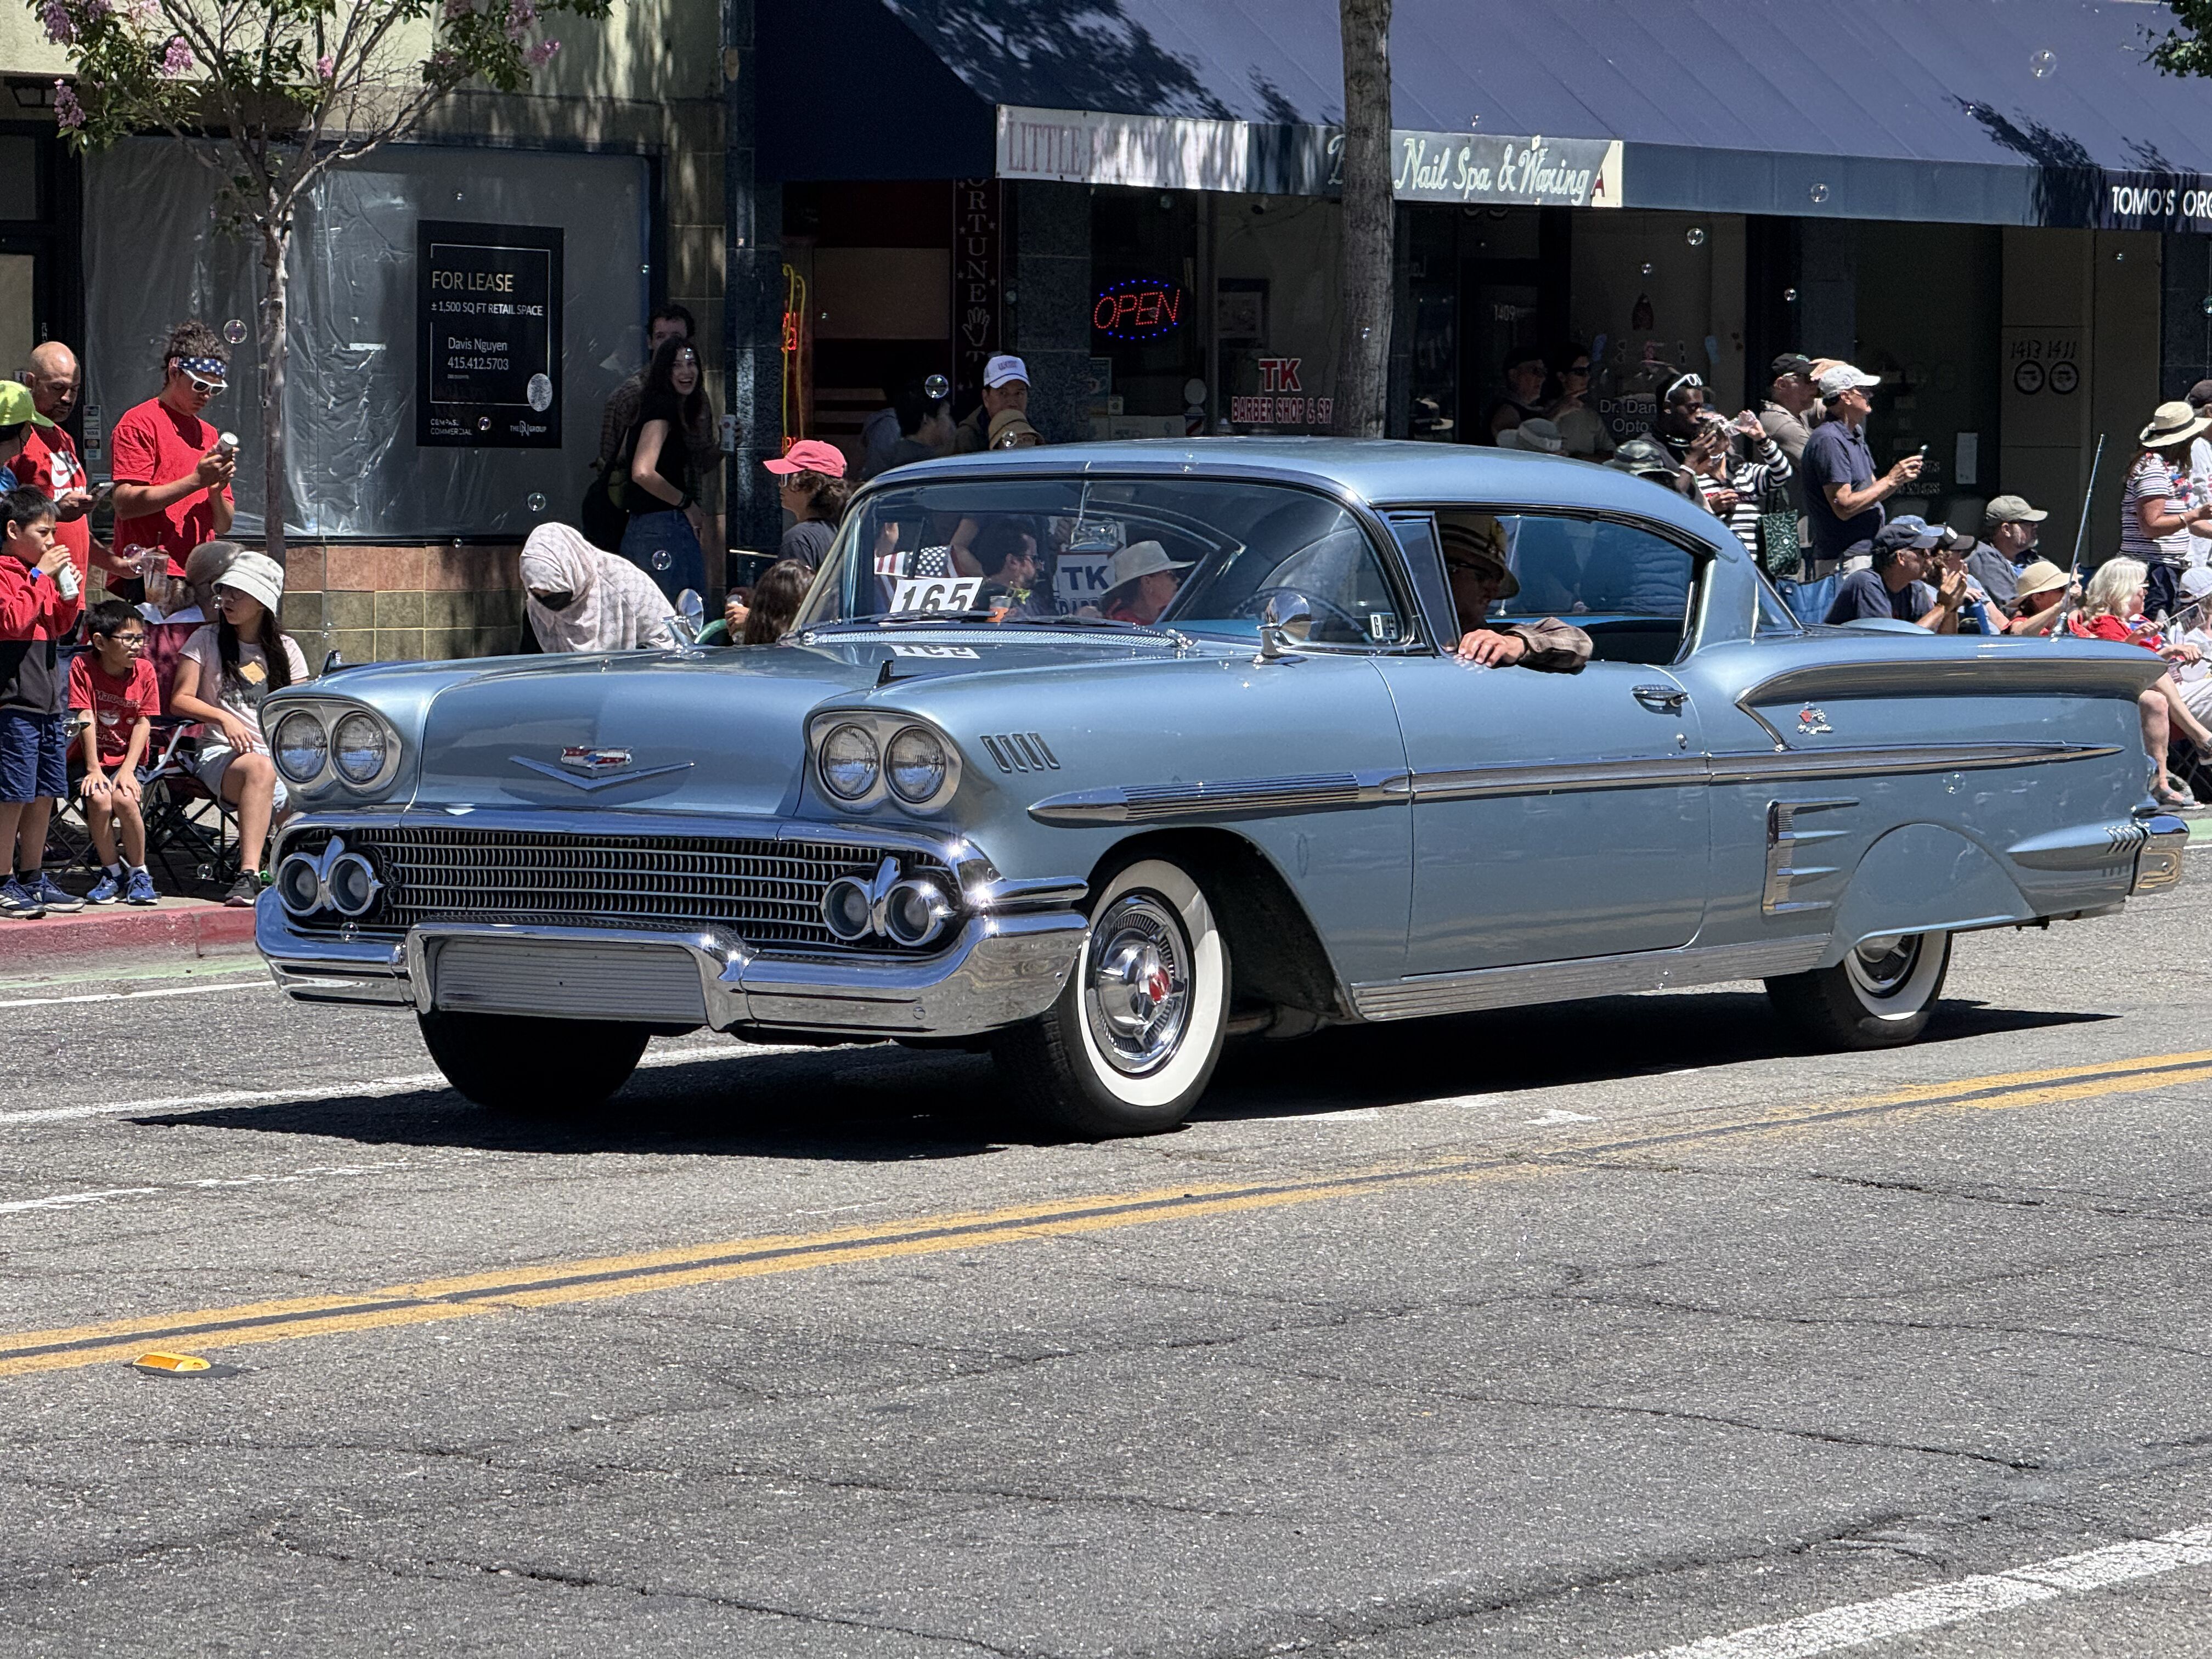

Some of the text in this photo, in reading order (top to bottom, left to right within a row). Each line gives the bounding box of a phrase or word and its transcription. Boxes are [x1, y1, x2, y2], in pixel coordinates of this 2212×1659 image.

[1007, 121, 1082, 176] LITTLE
[1394, 138, 1450, 191] Nail
[1453, 146, 1491, 200] Spa
[1497, 143, 1517, 193] &
[1518, 148, 1590, 206] Waxing
[2112, 186, 2176, 216] TOMO'S
[431, 270, 514, 292] FOR LEASE
[439, 301, 461, 313] 1,500
[462, 302, 475, 315] SQ
[476, 303, 487, 313] FT
[488, 304, 516, 315] RETAIL
[517, 304, 544, 317] SPACE
[1094, 288, 1181, 329] OPEN
[448, 337, 508, 353] Davis Nguyen
[447, 357, 509, 370] 415.412.5703
[1258, 358, 1302, 392] TK
[1232, 396, 1274, 424] BARBER
[1276, 397, 1305, 424] SHOP
[1307, 397, 1316, 425] &
[1599, 399, 1620, 414] Dr.
[1061, 566, 1110, 591] TK
[901, 583, 975, 612] 165
